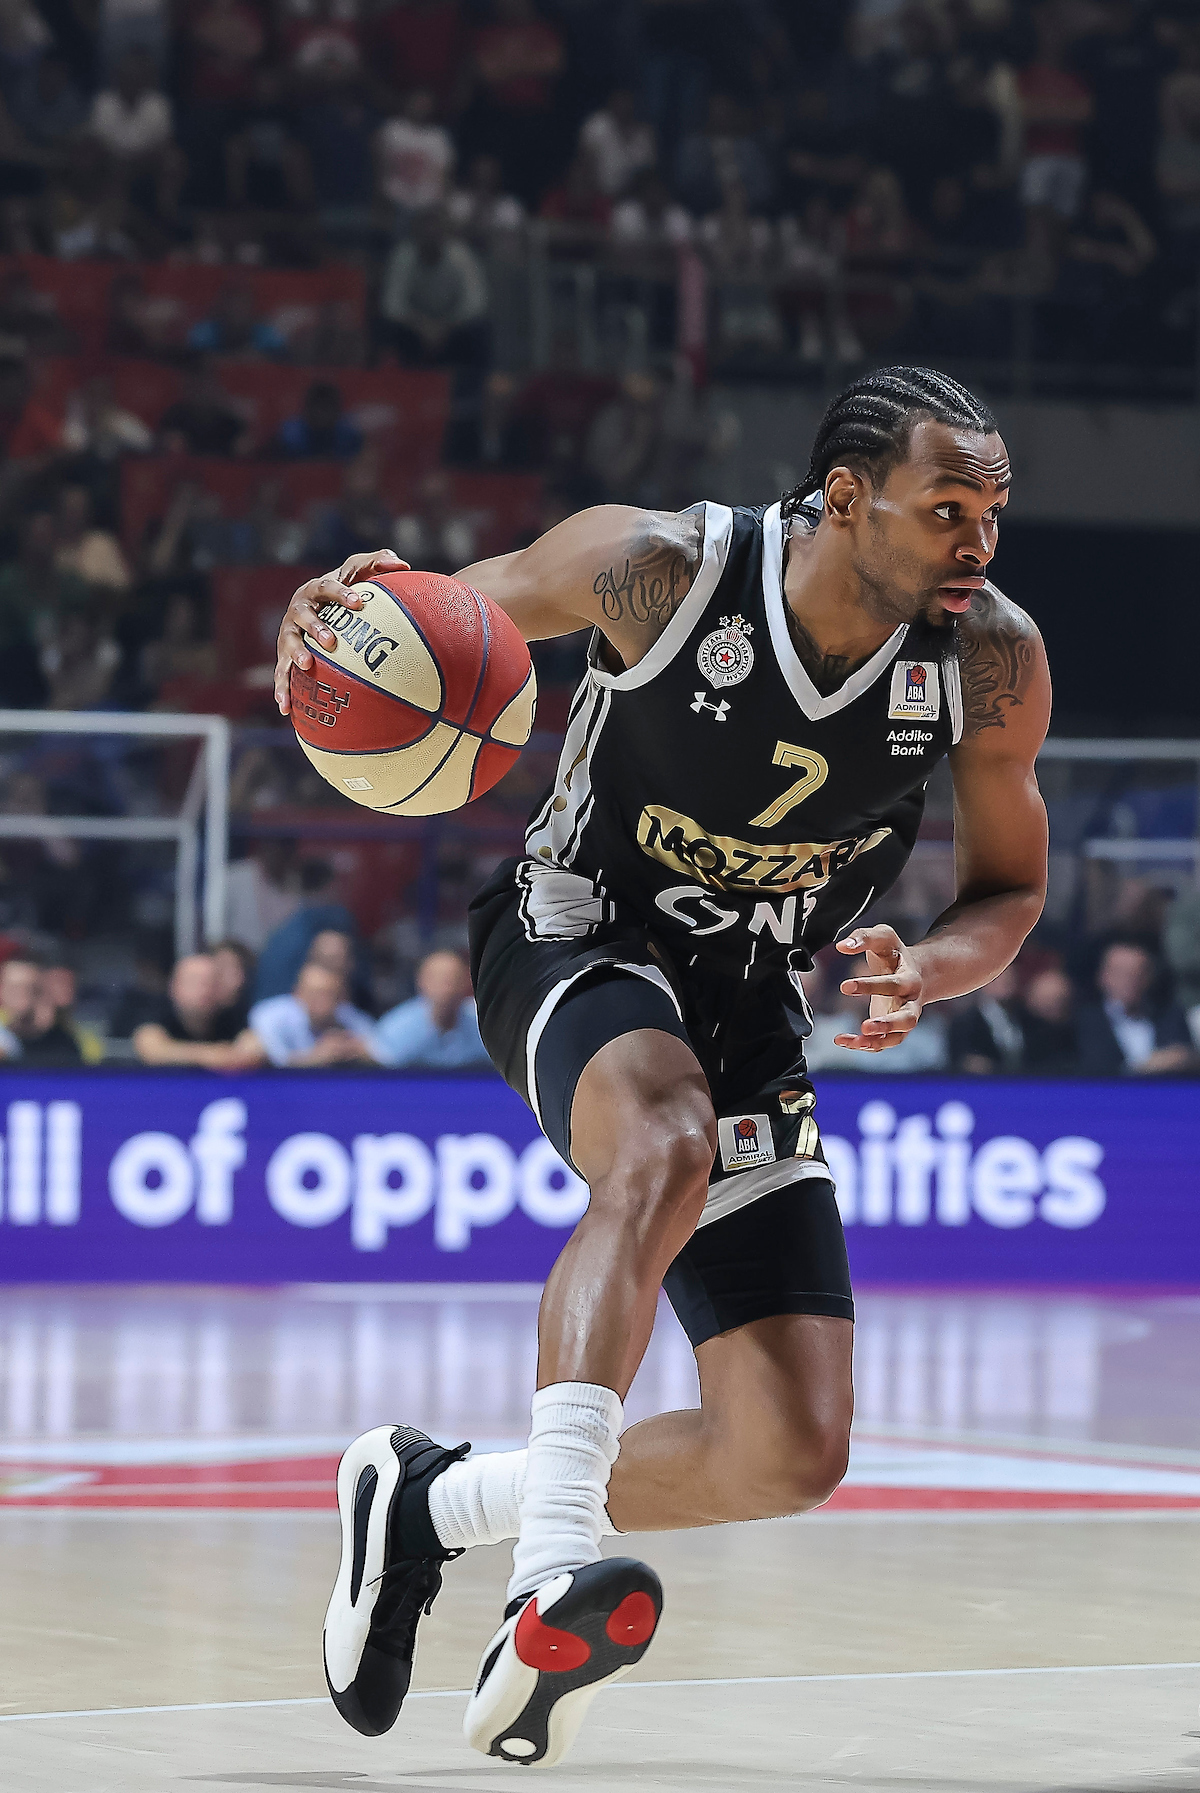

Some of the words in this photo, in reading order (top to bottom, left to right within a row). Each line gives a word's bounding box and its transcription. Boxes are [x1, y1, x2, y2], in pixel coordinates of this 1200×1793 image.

[907, 685, 924, 701] ABA
[894, 703, 937, 713] ADMIRAL
[886, 729, 934, 742] Addiko
[890, 743, 925, 756] Bank
[748, 740, 829, 828] 7
[645, 814, 866, 887] MOZZAR
[738, 1137, 758, 1152] ABA
[108, 1097, 248, 1228] of
[728, 1150, 773, 1164] ADMIRAL
